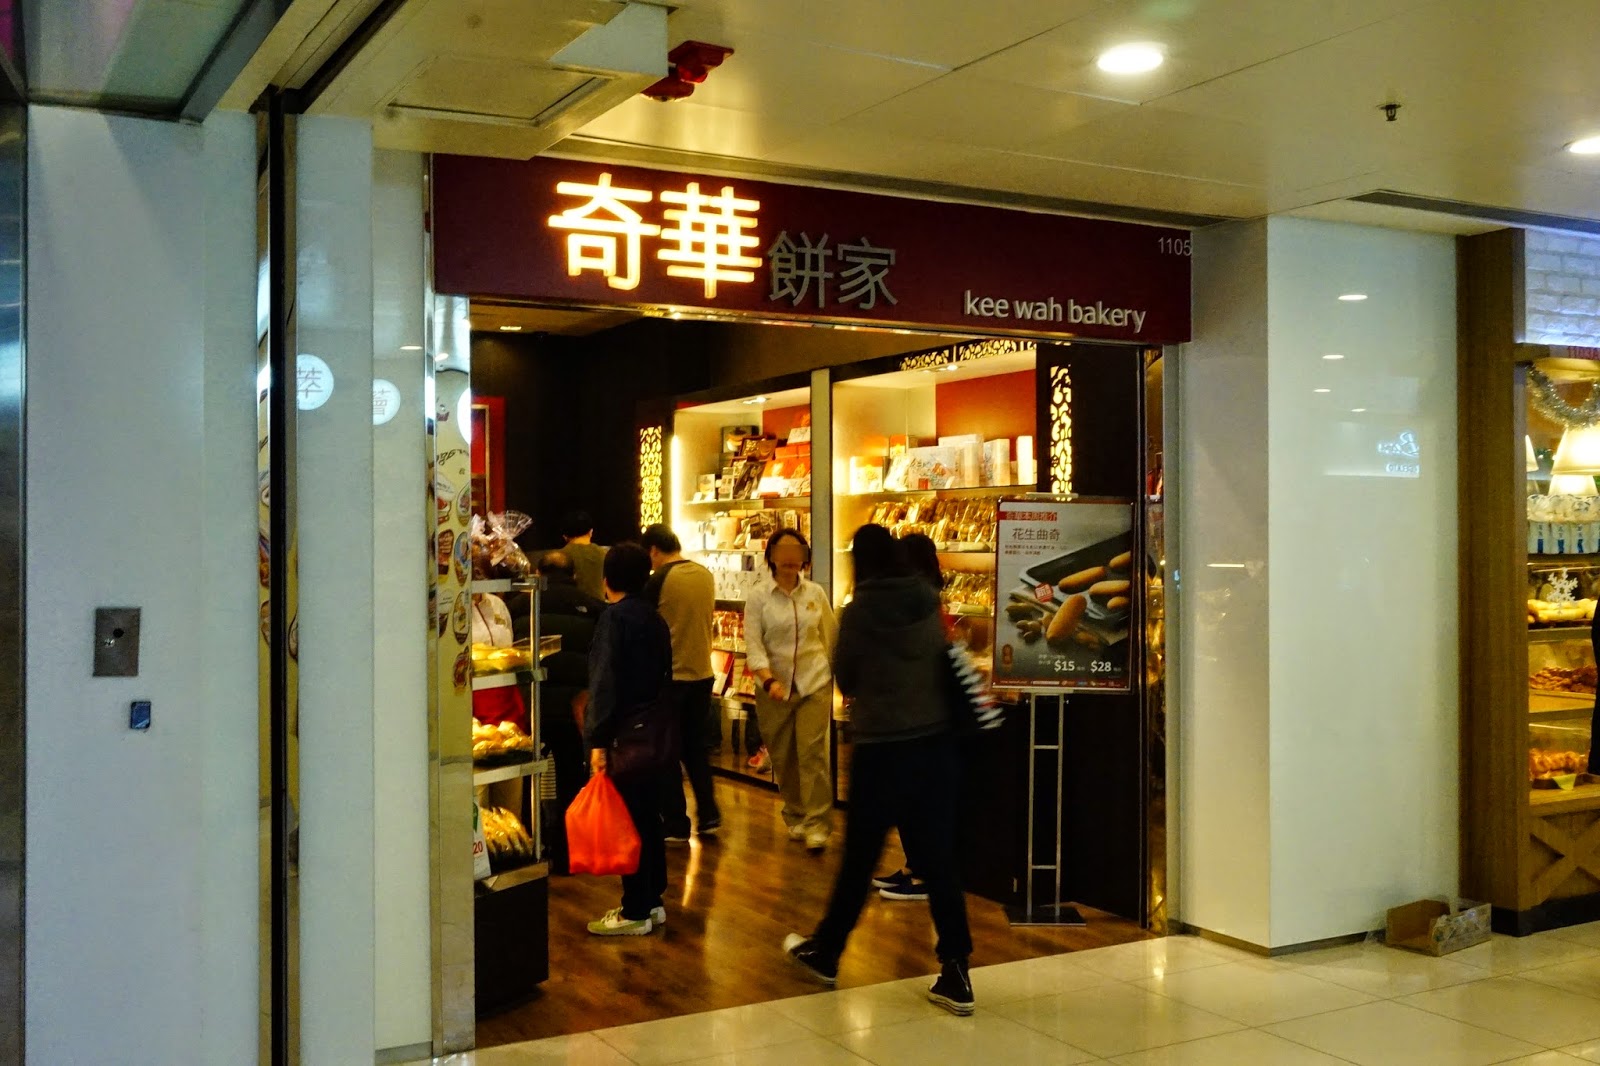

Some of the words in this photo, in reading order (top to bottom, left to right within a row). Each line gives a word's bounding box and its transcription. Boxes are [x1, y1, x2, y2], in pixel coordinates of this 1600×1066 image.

[548, 171, 900, 310] 奇華餅家
[1157, 236, 1192, 257] 1105
[964, 289, 1009, 318] kee
[1013, 296, 1063, 322] wah
[1067, 298, 1147, 334] bakery
[1012, 527, 1060, 541] 花生曲奇
[1054, 659, 1075, 673] $15
[1090, 660, 1112, 673] $28
